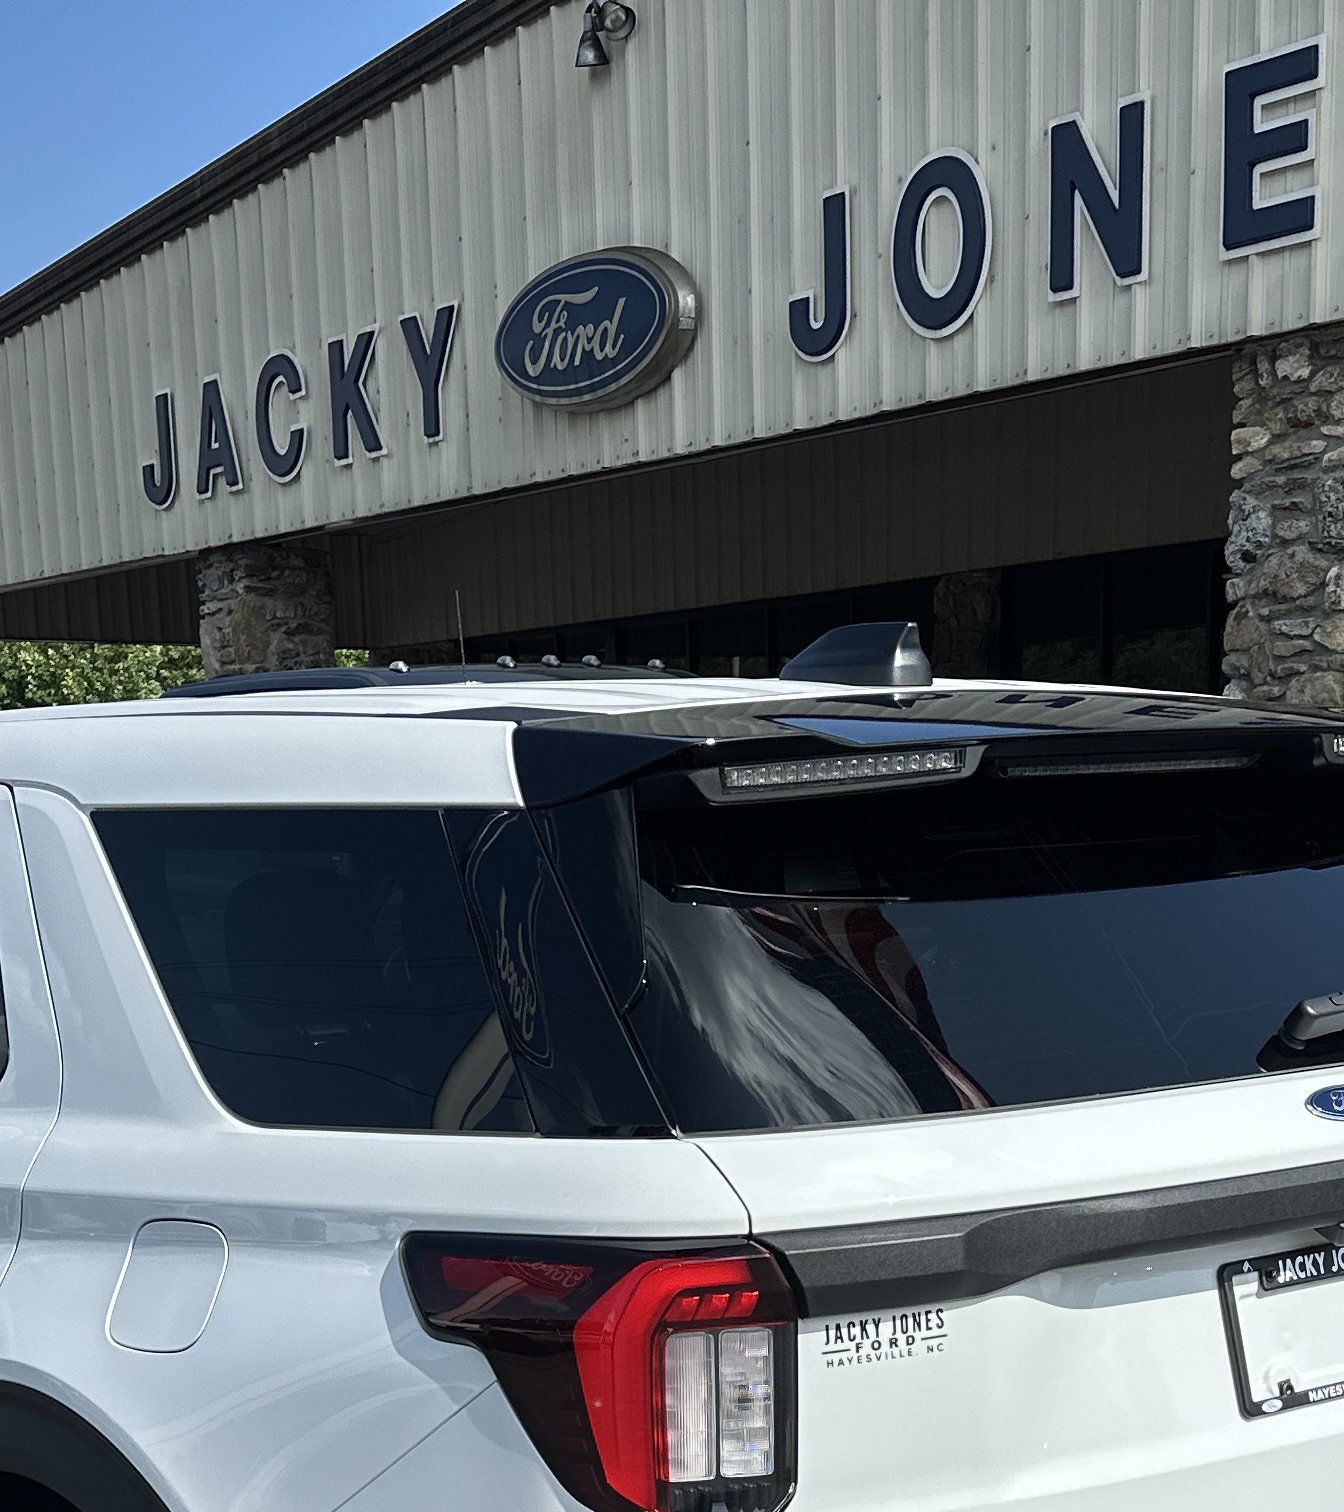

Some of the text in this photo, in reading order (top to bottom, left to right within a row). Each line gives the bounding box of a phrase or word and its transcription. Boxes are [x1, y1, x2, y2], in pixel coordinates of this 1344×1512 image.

[524, 286, 626, 377] Ford
[143, 300, 458, 510] JACKY
[1277, 1250, 1325, 1284] JACKY
[824, 1307, 945, 1345] JACKY JONES
[855, 1334, 916, 1353] FORD
[926, 1342, 945, 1354] NC
